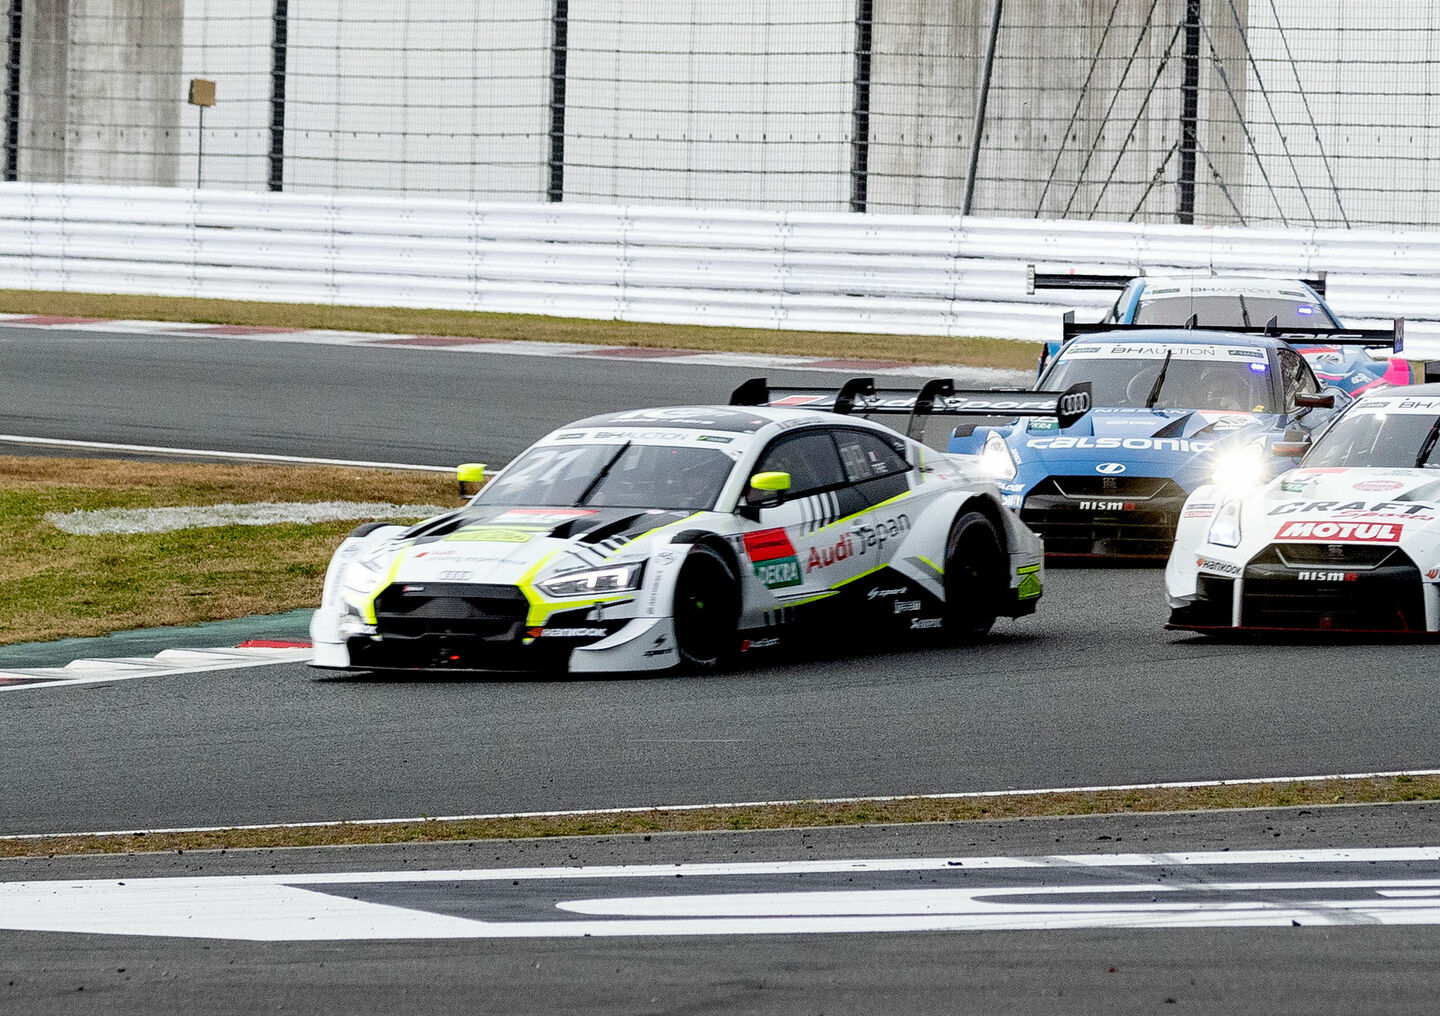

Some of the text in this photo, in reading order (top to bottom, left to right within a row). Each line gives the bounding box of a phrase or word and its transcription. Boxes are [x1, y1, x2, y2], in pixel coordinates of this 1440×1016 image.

[1266, 500, 1436, 517] CRAFT
[851, 512, 913, 556] Japan
[1281, 522, 1402, 539] MOTUL
[805, 532, 855, 574] Audi
